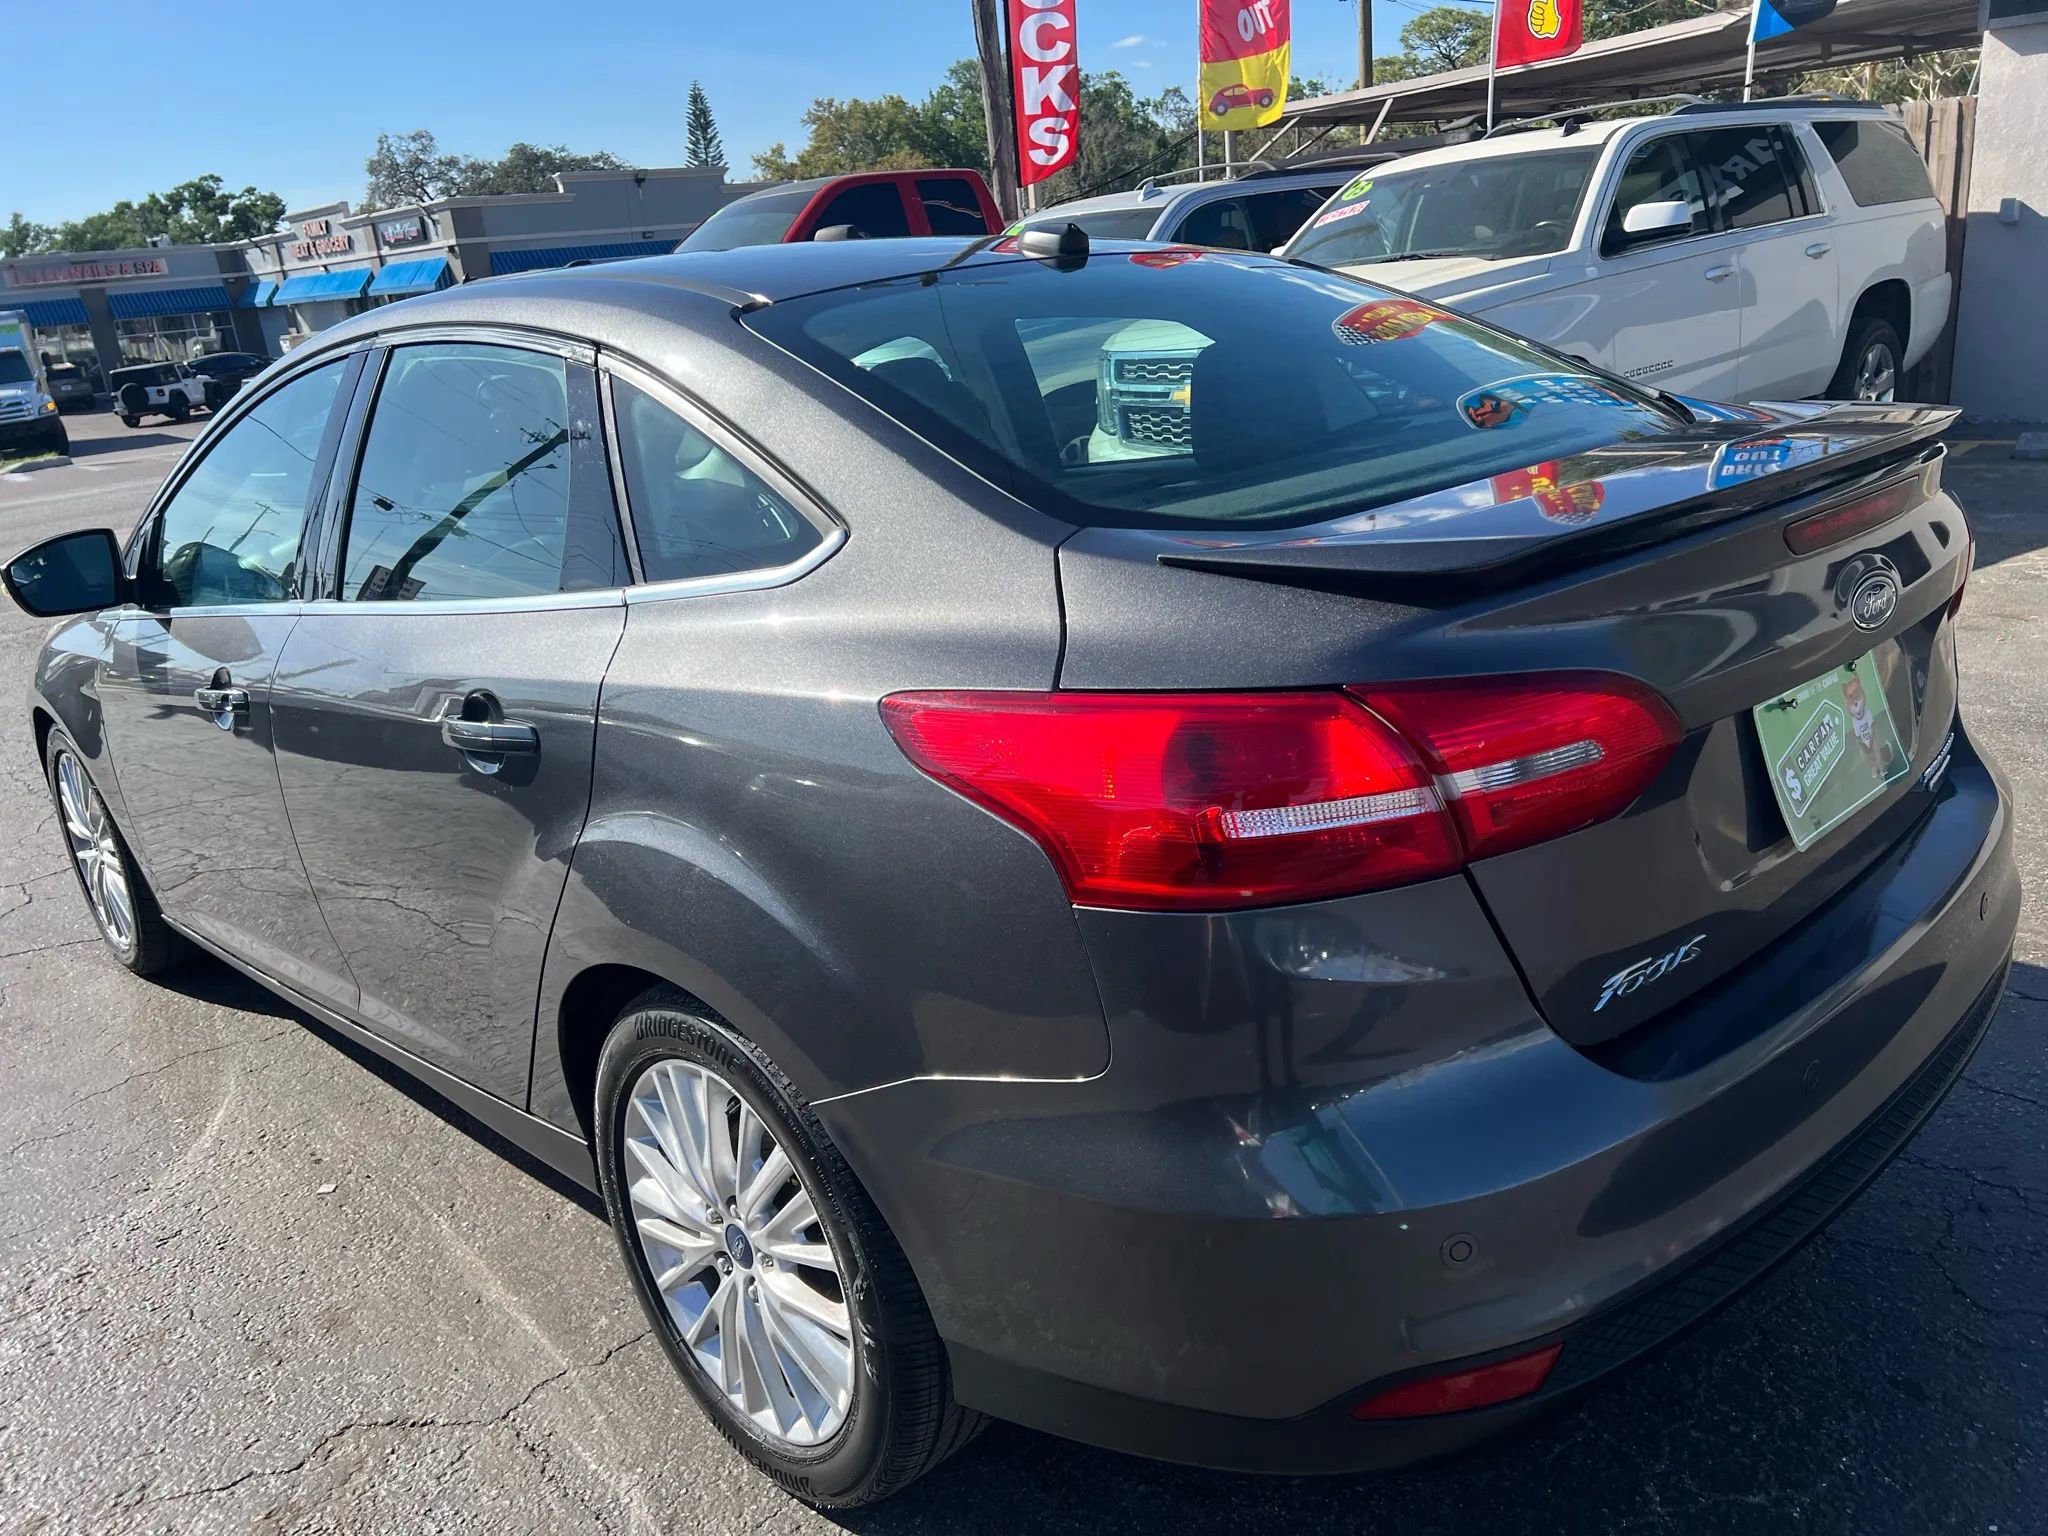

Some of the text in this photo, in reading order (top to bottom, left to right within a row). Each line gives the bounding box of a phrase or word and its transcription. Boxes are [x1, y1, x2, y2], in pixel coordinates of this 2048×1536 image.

[1237, 0, 1274, 42] OUT
[1018, 0, 1076, 166] CKS
[302, 219, 327, 237] FAMILY
[135, 260, 161, 274] SPA
[1797, 714, 1834, 770] CARFAX
[1804, 732, 1840, 787] GREAT VALUE
[1593, 934, 1707, 1012] Focus
[634, 1012, 742, 1075] BRIDGESTONE
